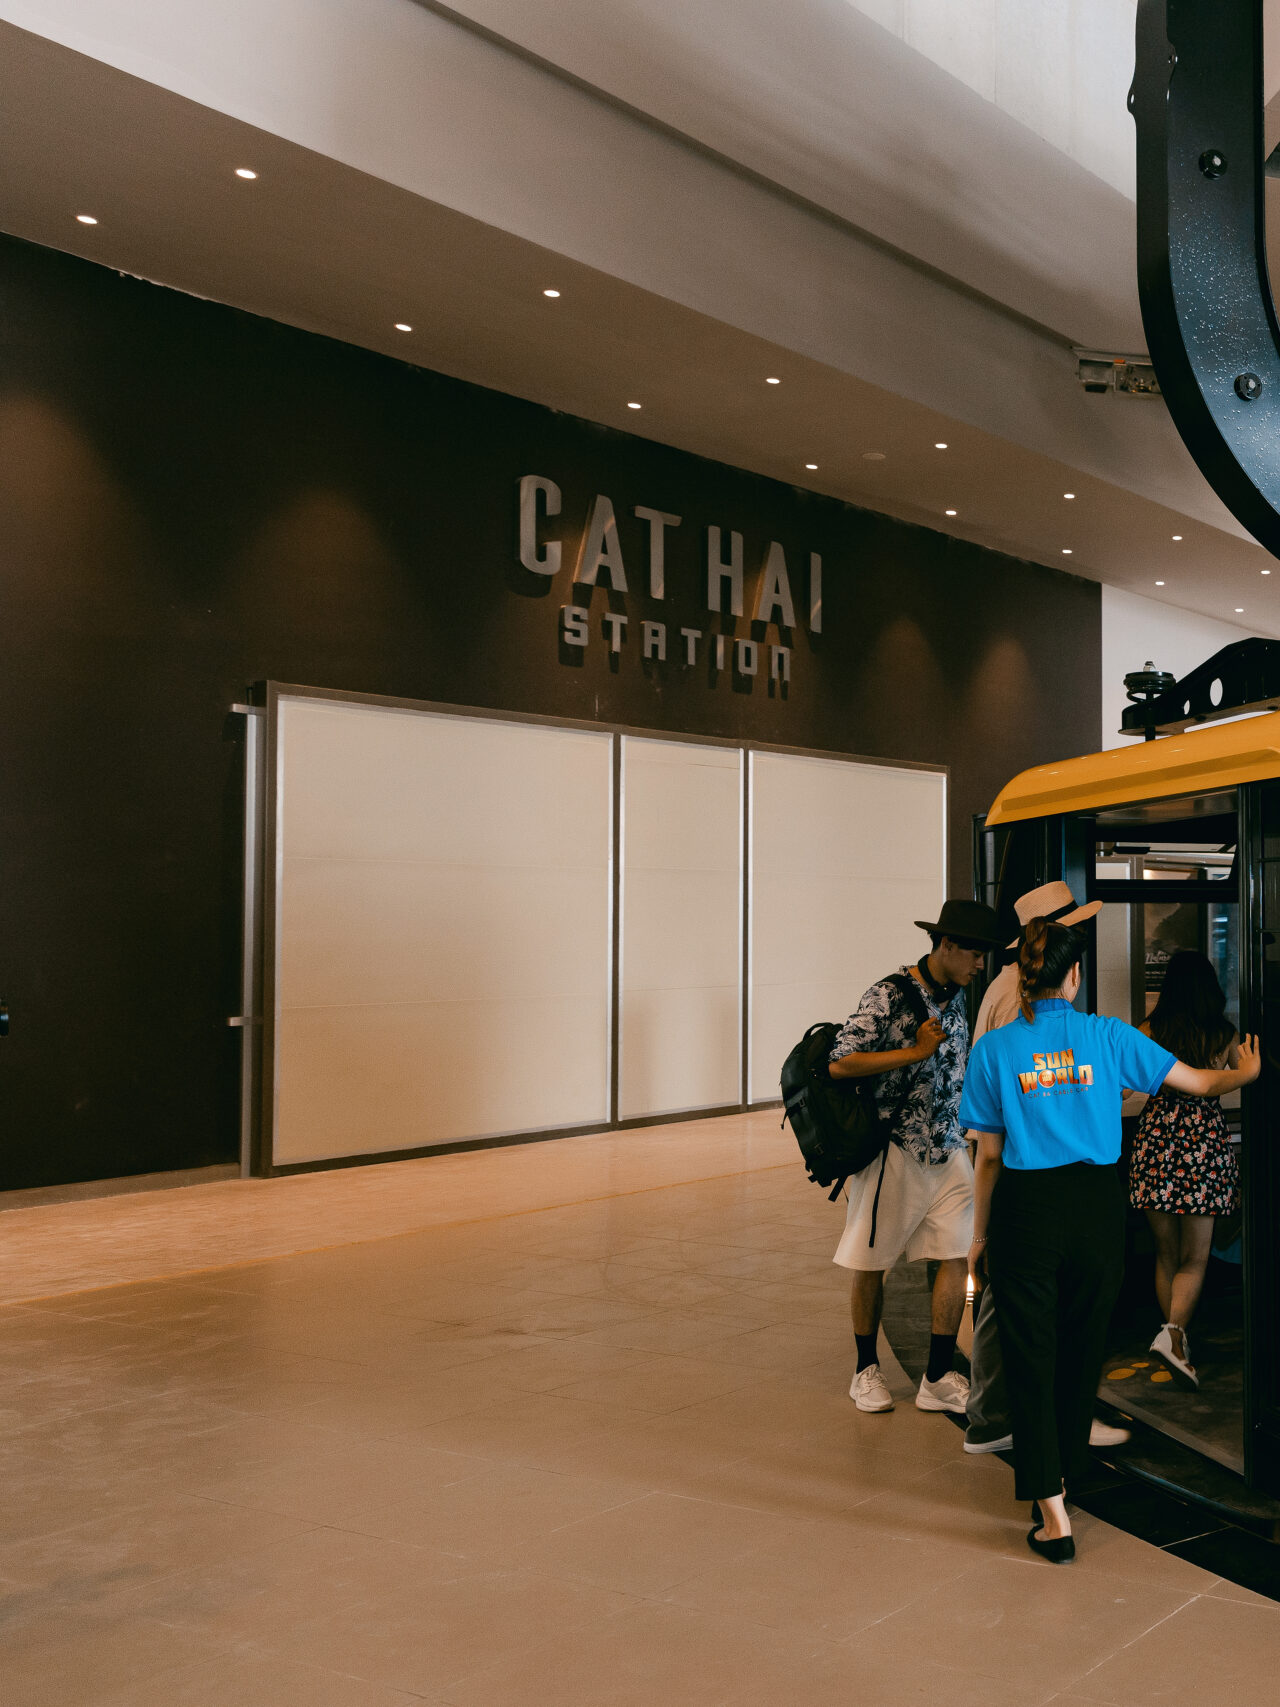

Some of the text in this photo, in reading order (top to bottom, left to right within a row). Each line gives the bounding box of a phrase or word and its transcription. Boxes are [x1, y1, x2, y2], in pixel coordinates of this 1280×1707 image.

[519, 474, 823, 634] CAT HAI
[561, 604, 791, 682] STATION
[1018, 1065, 1094, 1094] WORLD
[1033, 1048, 1074, 1070] SUN
